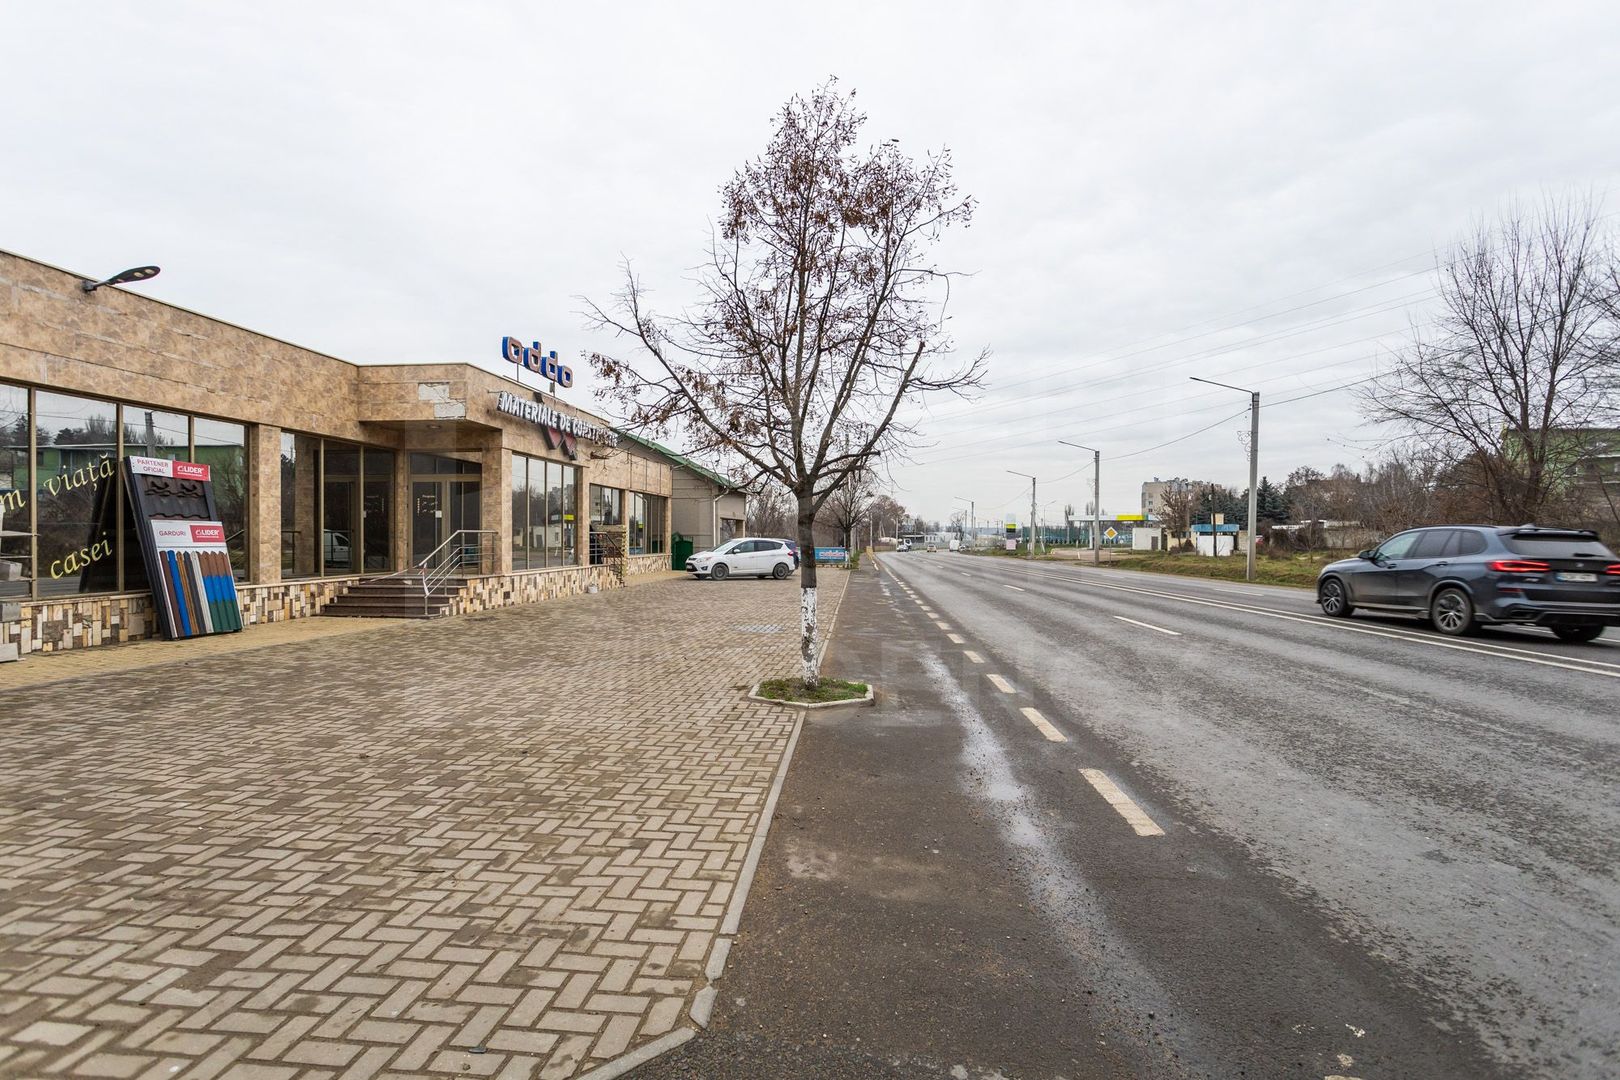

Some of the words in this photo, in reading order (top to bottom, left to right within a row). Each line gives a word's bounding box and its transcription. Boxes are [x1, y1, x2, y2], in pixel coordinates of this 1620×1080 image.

[498, 391, 557, 429] MATERIALE
[559, 413, 571, 433] DE
[137, 459, 168, 467] PARTENER
[50, 531, 113, 580] casei
